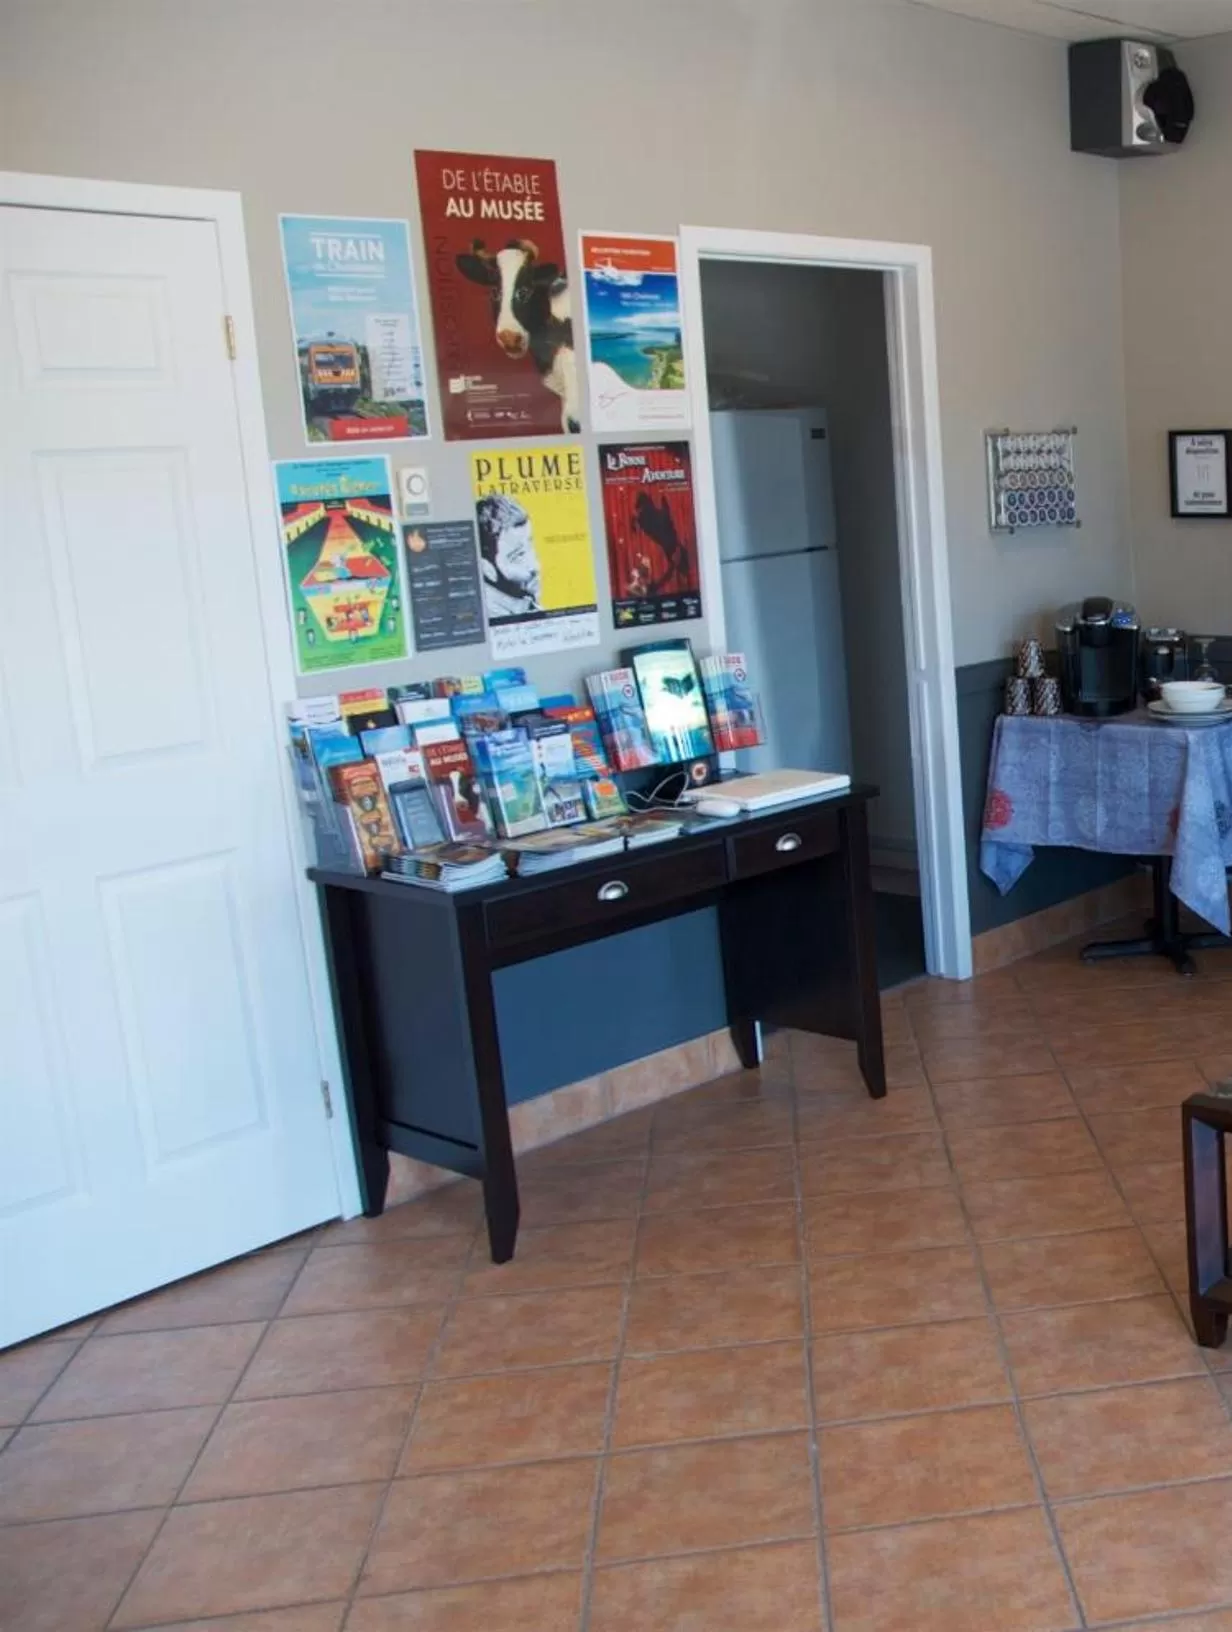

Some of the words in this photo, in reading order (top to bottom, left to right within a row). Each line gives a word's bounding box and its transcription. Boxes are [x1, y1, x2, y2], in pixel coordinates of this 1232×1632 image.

[442, 168, 466, 191] DE
[472, 167, 540, 195] L'ÉTABLE
[446, 197, 474, 218] AU
[481, 195, 544, 221] MUSÉE
[311, 236, 384, 261] TRAIN
[475, 452, 581, 481] PLUME
[477, 478, 583, 497] LATRAVERSE
